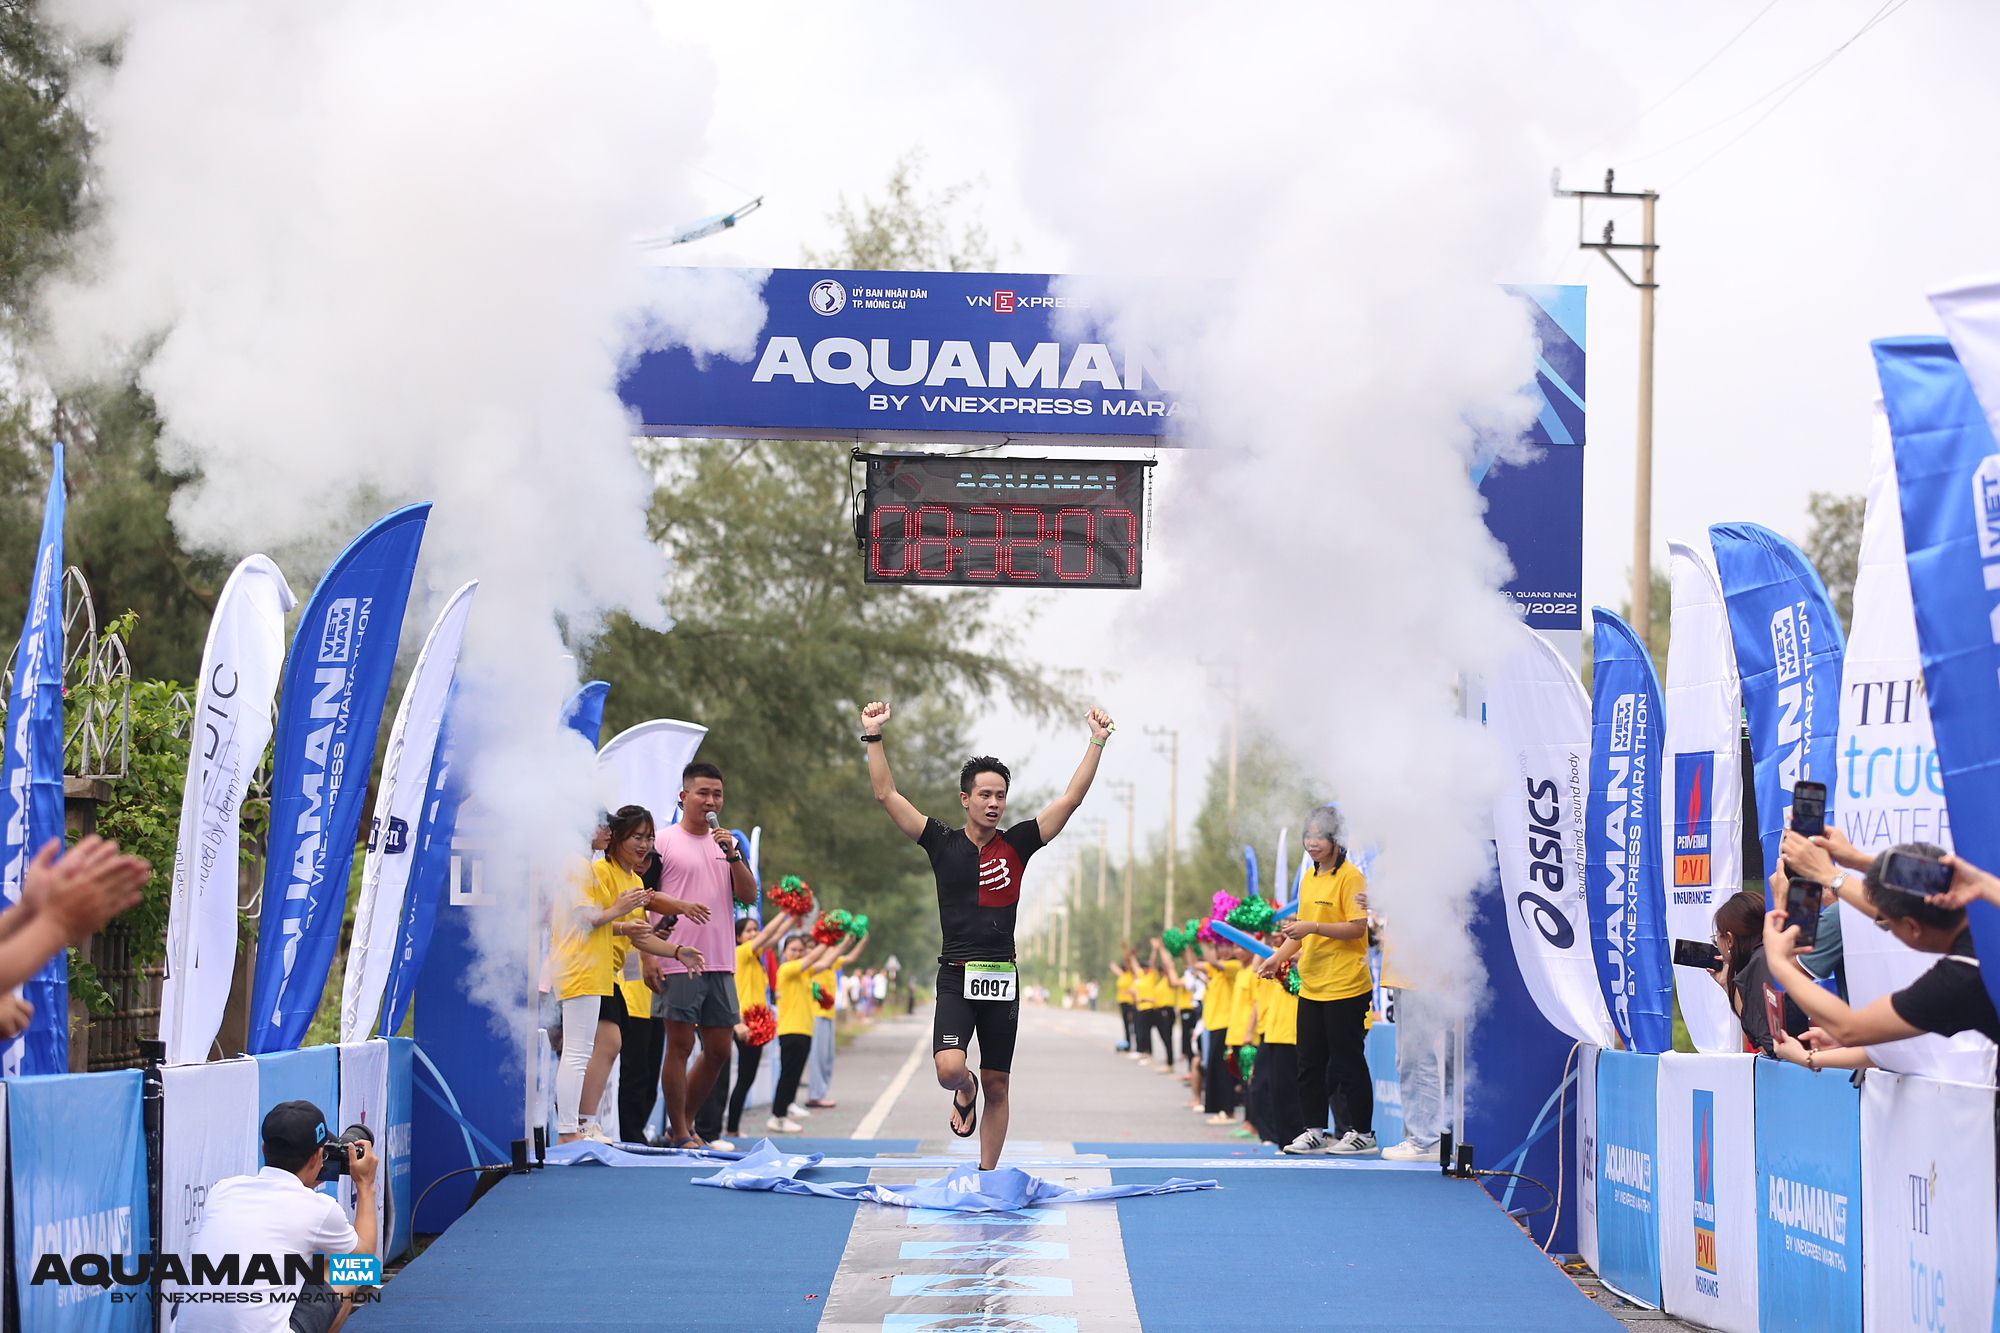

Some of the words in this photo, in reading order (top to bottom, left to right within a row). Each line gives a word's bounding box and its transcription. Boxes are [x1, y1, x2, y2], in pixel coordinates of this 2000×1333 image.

[852, 284, 865, 298] UỶ
[866, 288, 884, 298] BAN
[885, 285, 908, 299] NHÂN
[910, 286, 928, 299] DÂN
[852, 299, 864, 309] TP.
[865, 297, 888, 309] MÓNG
[889, 297, 906, 310] CÁI
[752, 337, 1183, 391] AQUAMAN
[869, 394, 910, 411] BY
[920, 396, 1093, 415] VNEXPRESS
[1102, 399, 1192, 417] MARA
[871, 505, 1136, 580] 08:32:07
[1509, 603, 1577, 615] 0/2022
[322, 608, 339, 659] VIET
[333, 607, 351, 658] NAM
[1774, 623, 1785, 678] VIET
[1783, 617, 1796, 675] NAM
[1797, 601, 1814, 754] MARATHON
[1622, 702, 1632, 748] NAM
[1851, 679, 1914, 727] TH
[1614, 704, 1626, 748] VIET
[1568, 752, 1580, 785] body
[1630, 693, 1647, 819] MARATHON
[1845, 735, 1945, 799] true
[1570, 786, 1583, 824] sound
[206, 822, 228, 846] by
[1573, 828, 1585, 862] mind,
[1575, 862, 1586, 900] sound
[1626, 824, 1642, 958] VNEXPRESS
[1682, 859, 1704, 881] PVI
[1605, 756, 1638, 1052] QUAMAN
[404, 933, 415, 961] BY
[971, 979, 1010, 997] 6097
[1628, 971, 1637, 996] BY
[1605, 1143, 1644, 1191] AQUAMAN
[1769, 1174, 1834, 1242] AQUAMAN
[1909, 1174, 1929, 1235] TH
[1698, 1233, 1713, 1265] PVI
[1785, 1234, 1793, 1251] BY
[1695, 1274, 1719, 1298] INSURANCE
[1909, 1241, 1945, 1333] true
